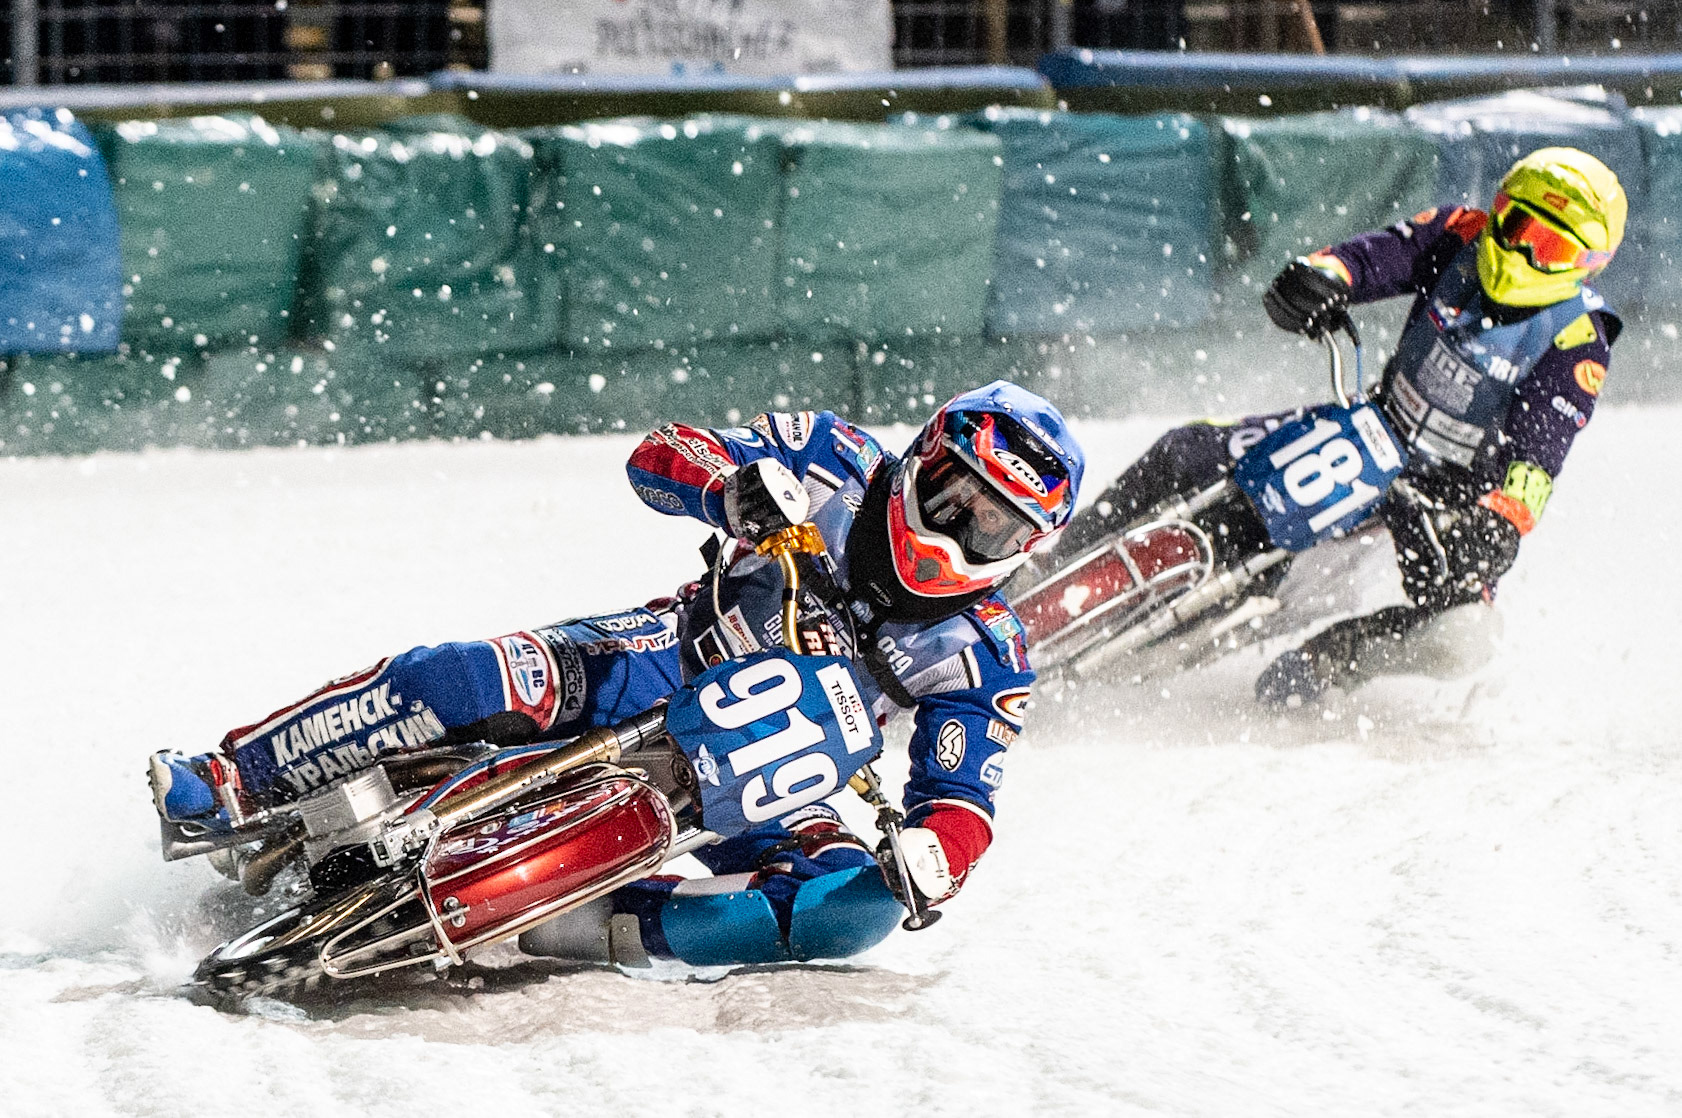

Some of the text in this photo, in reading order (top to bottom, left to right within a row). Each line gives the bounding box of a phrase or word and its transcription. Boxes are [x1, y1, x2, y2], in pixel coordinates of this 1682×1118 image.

[1269, 417, 1381, 534] 181
[698, 657, 839, 823] 919
[830, 680, 859, 734] TISSOT
